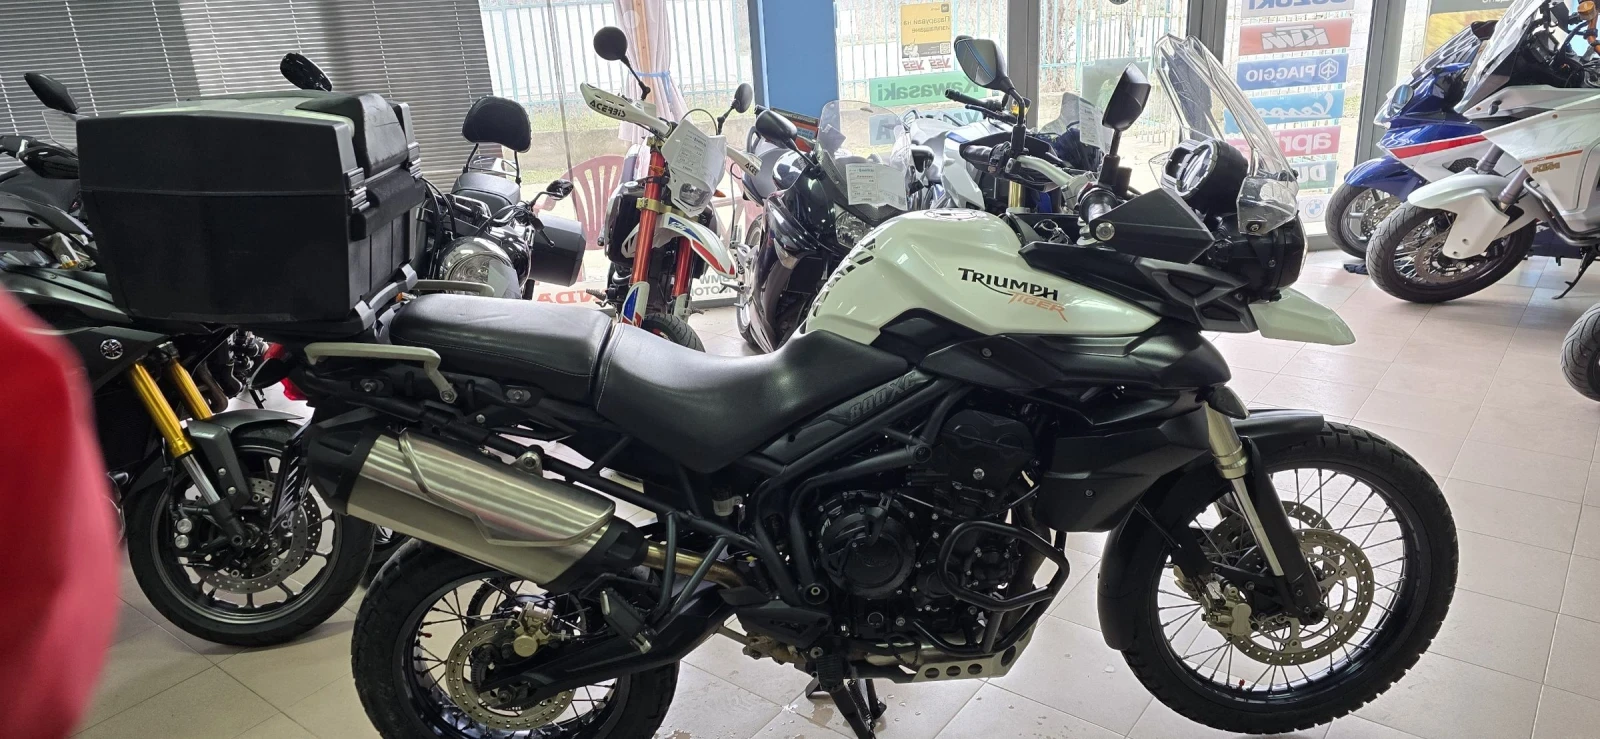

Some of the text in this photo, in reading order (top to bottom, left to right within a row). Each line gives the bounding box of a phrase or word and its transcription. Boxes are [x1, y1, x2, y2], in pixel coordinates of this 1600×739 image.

[589, 100, 627, 118] ACERBIS
[957, 267, 1059, 301] TRIUMPH
[1007, 290, 1069, 323] TIGER
